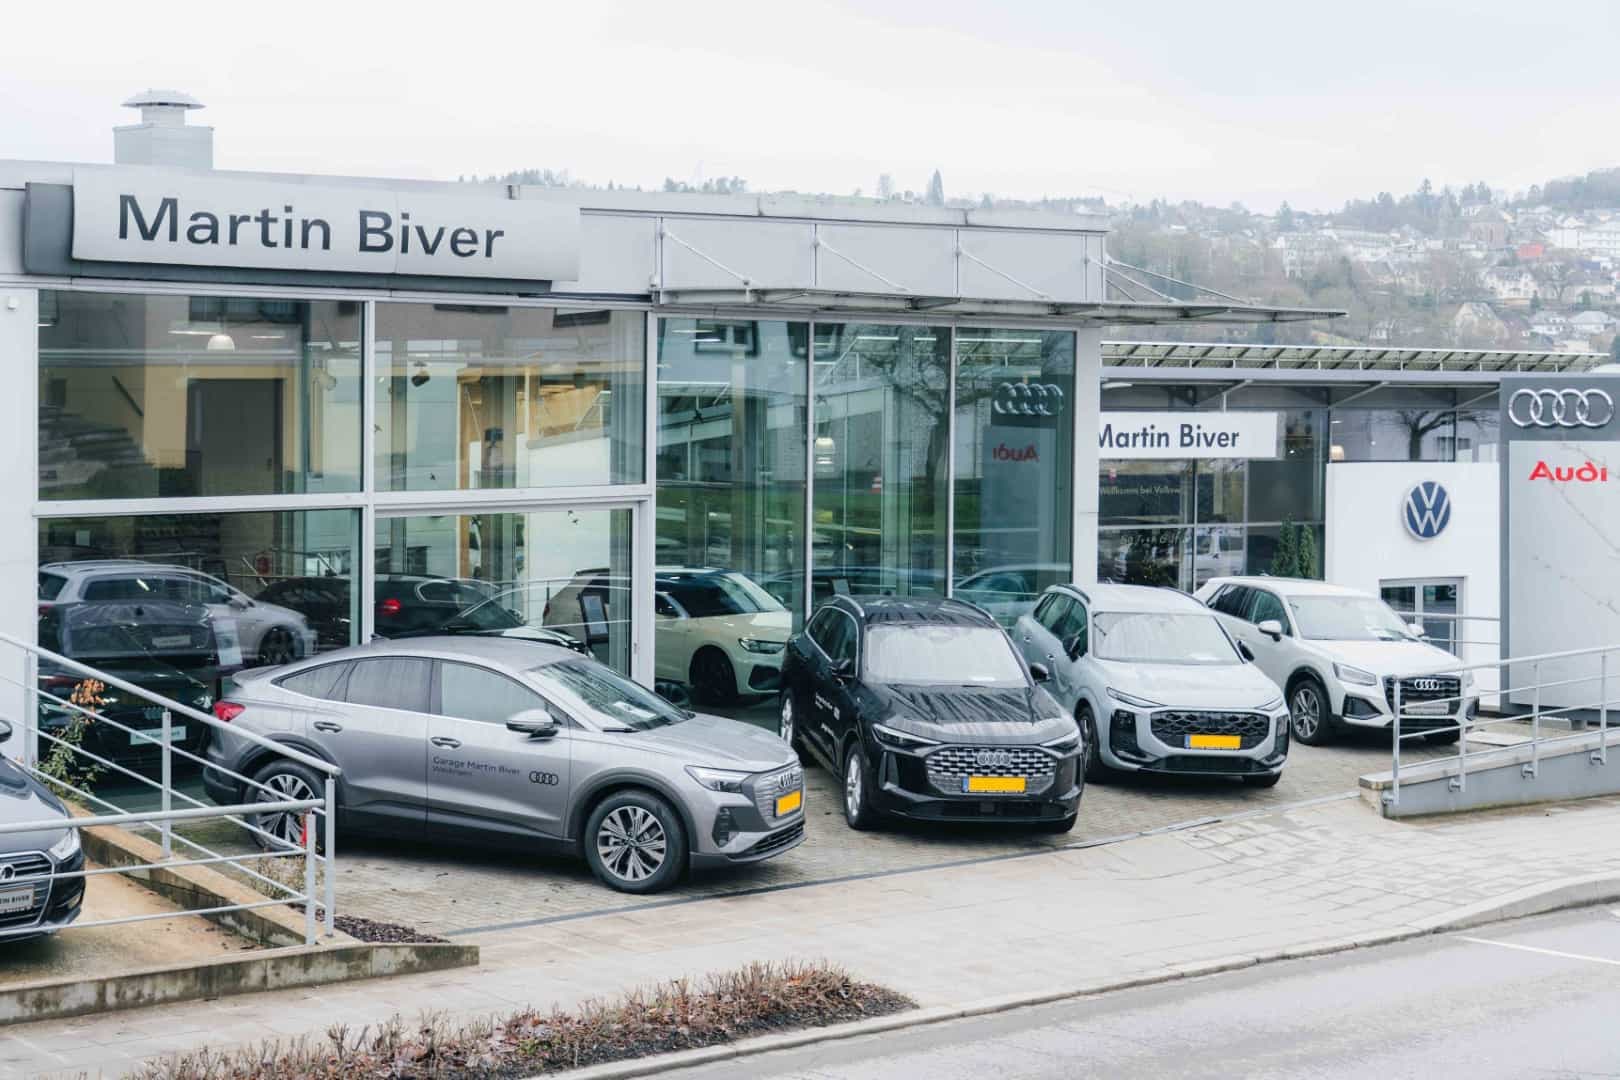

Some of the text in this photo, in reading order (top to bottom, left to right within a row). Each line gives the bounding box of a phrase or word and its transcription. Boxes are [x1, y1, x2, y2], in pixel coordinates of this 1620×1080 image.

[119, 194, 505, 259] Martin Biver
[1180, 423, 1240, 448] Biver
[1528, 460, 1608, 482] Audi
[1404, 481, 1451, 538] VW
[433, 756, 464, 768] Garage
[467, 761, 497, 773] Martin
